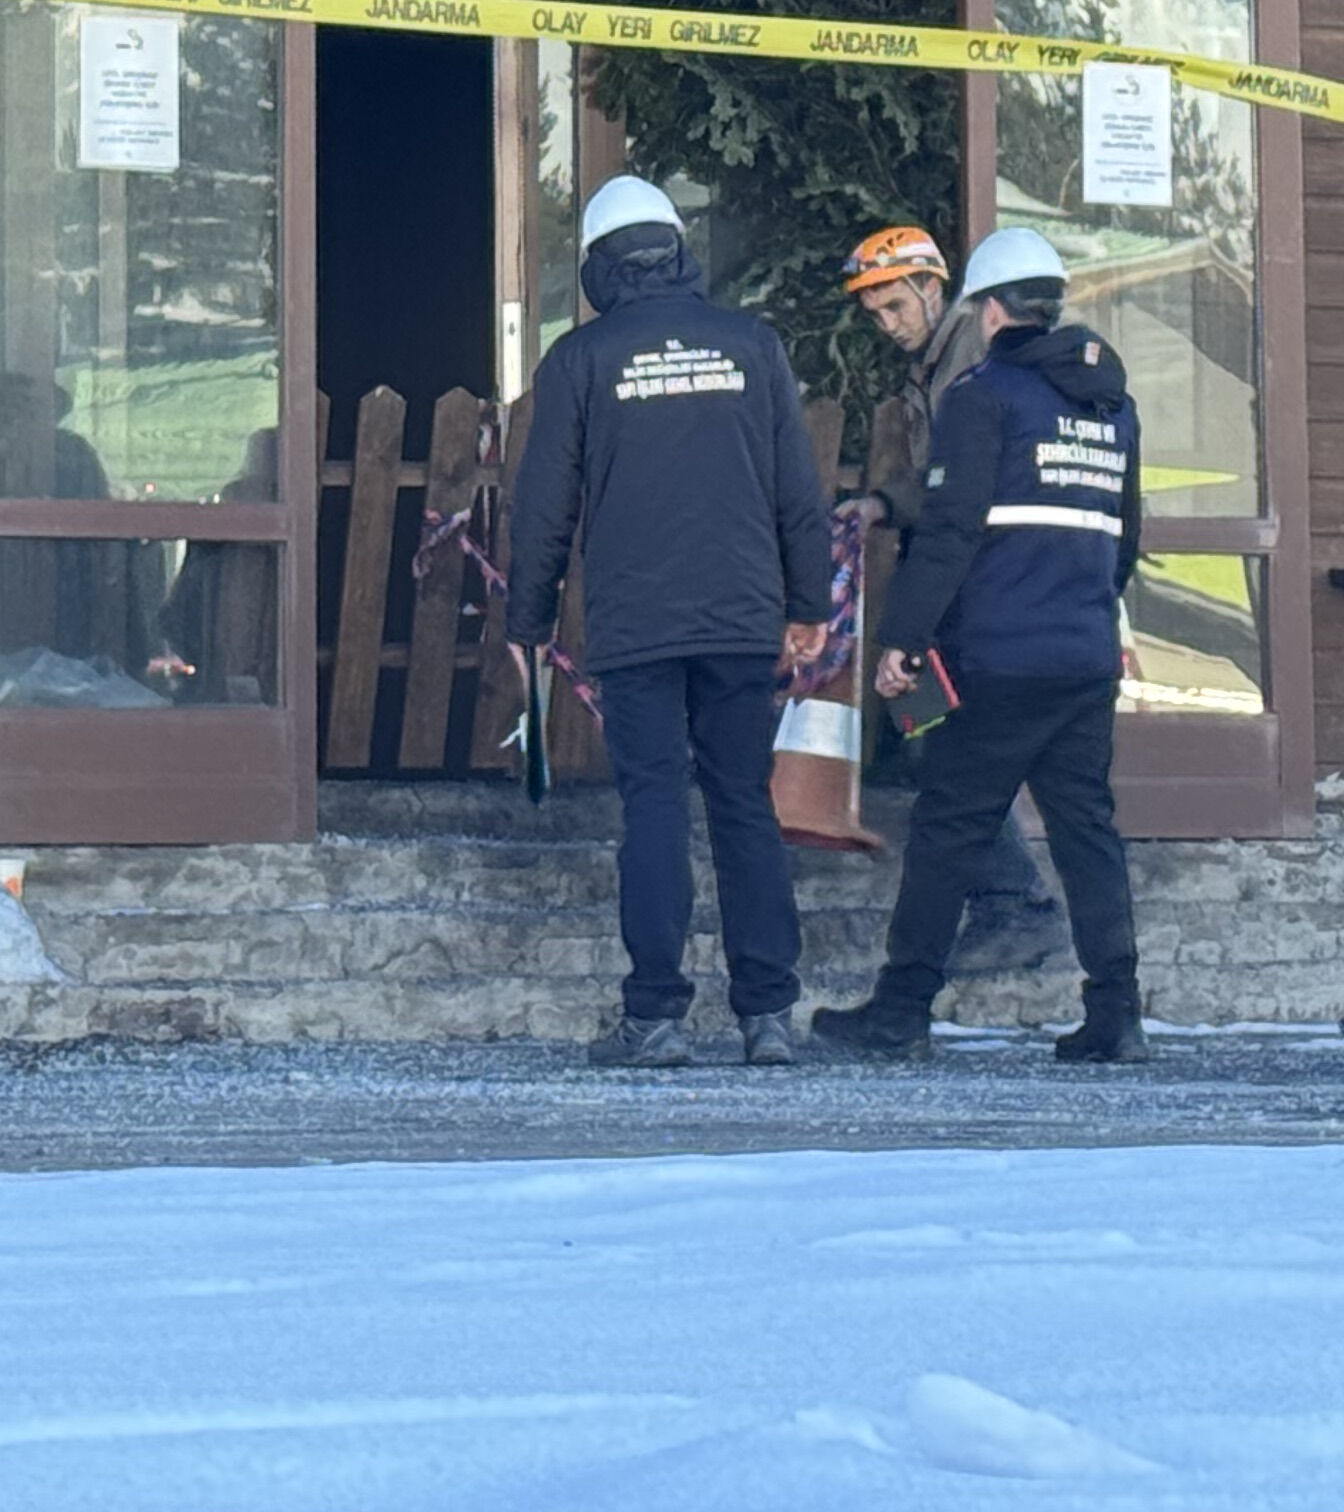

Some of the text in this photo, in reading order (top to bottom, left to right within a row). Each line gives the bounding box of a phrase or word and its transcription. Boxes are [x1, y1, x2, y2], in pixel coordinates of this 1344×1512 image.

[532, 8, 588, 35] OLAY
[809, 29, 919, 58] JANDARMA
[967, 38, 1021, 65] OLAY
[1228, 70, 1329, 110] JANDARMA
